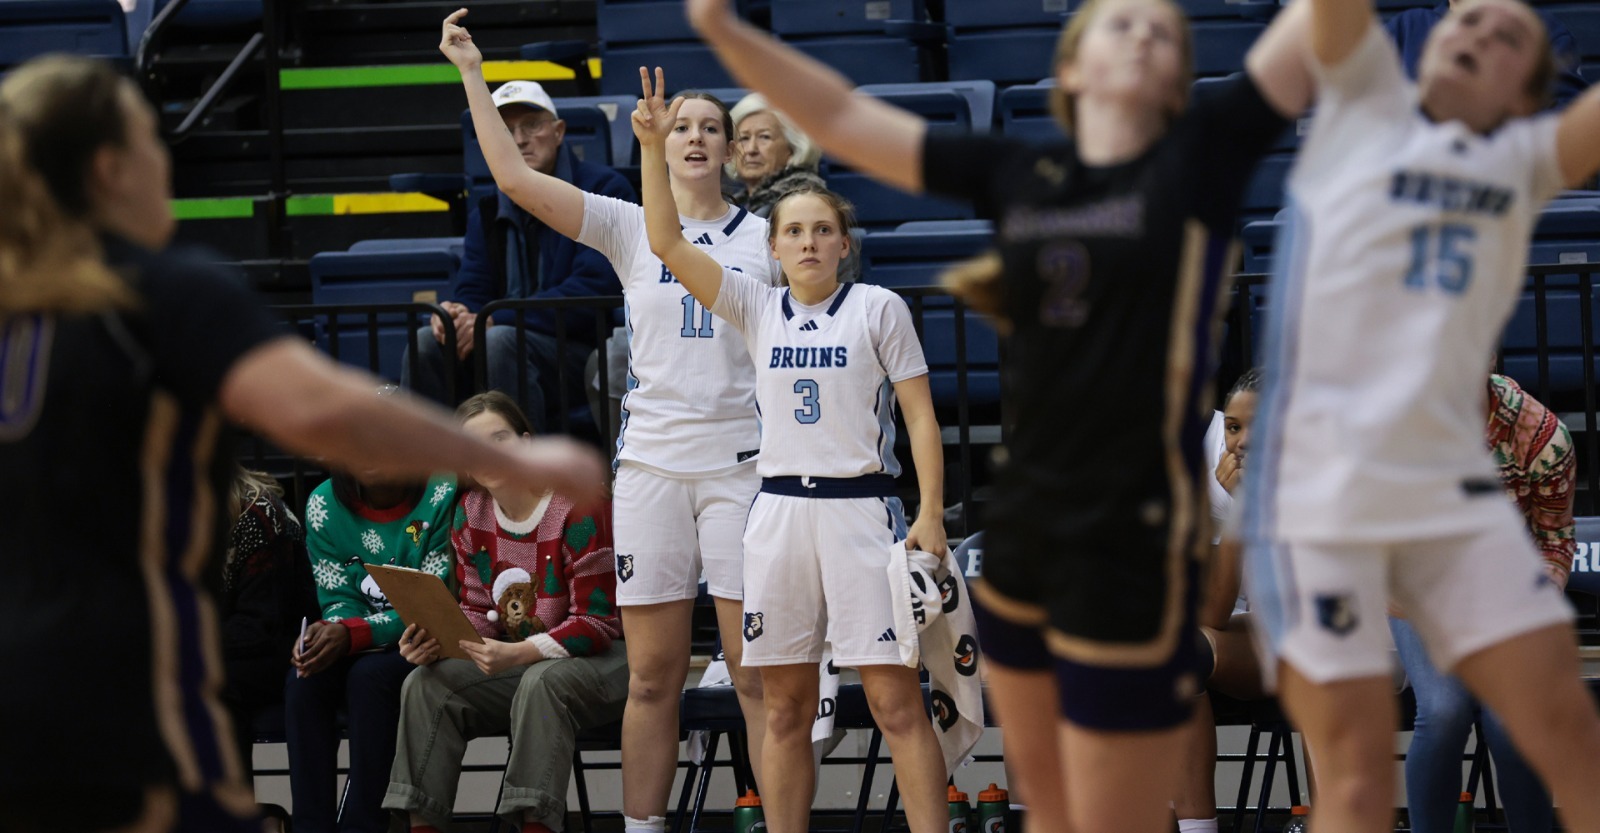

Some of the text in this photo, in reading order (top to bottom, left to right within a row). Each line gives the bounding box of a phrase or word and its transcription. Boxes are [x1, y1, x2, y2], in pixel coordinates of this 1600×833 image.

[1403, 224, 1477, 297] 15
[1037, 240, 1090, 329] 2
[681, 294, 714, 338] 11
[769, 346, 848, 369] BRUINS
[794, 379, 821, 424] 3
